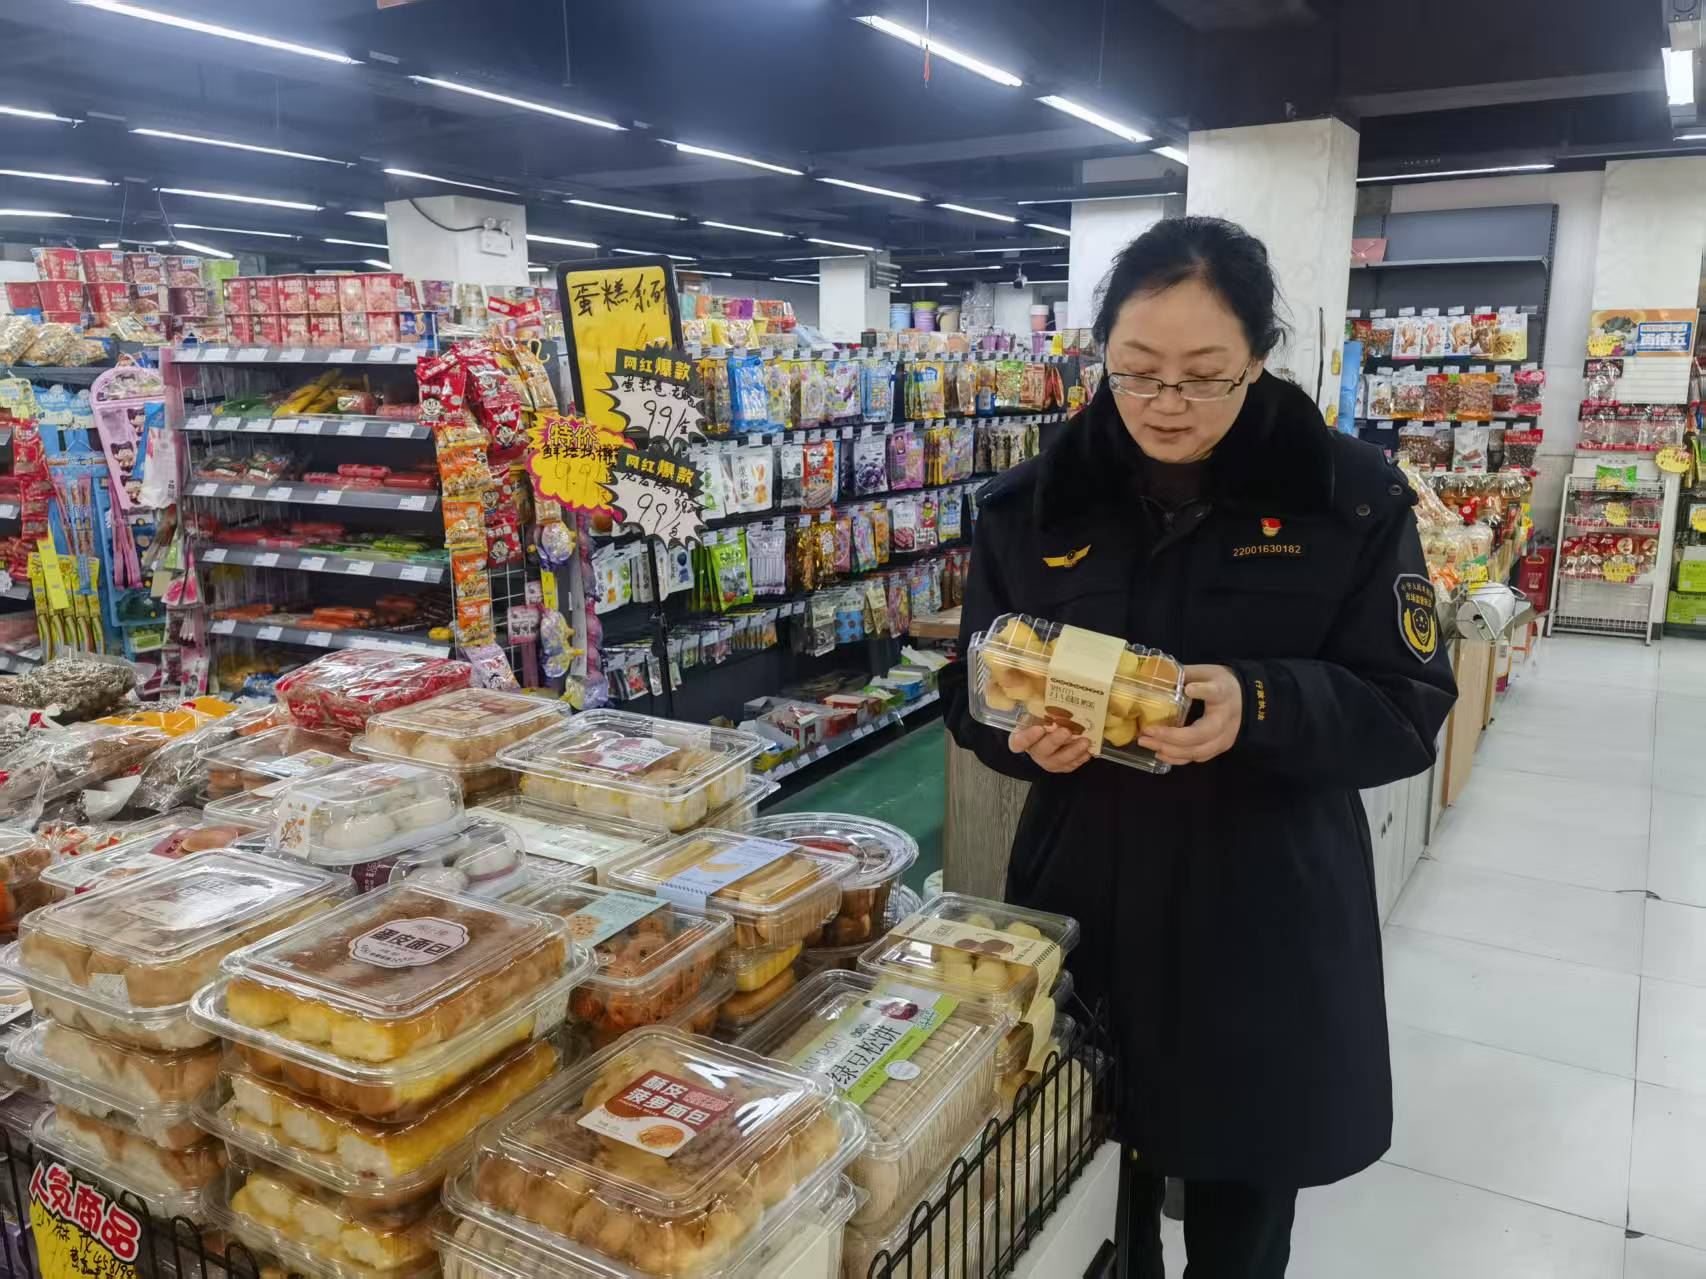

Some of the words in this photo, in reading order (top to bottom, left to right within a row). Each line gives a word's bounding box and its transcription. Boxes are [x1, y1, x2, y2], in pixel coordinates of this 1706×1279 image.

[623, 355, 692, 382] 网红爆款
[548, 421, 598, 449] 特价
[625, 453, 695, 487] 网红爆款
[1232, 544, 1302, 557] 22001630182
[370, 928, 451, 955] 蛋皮面包
[826, 1024, 902, 1085] 绿豆松饼
[641, 1075, 688, 1099] 酥皮
[624, 1087, 711, 1126] 菠萝面包
